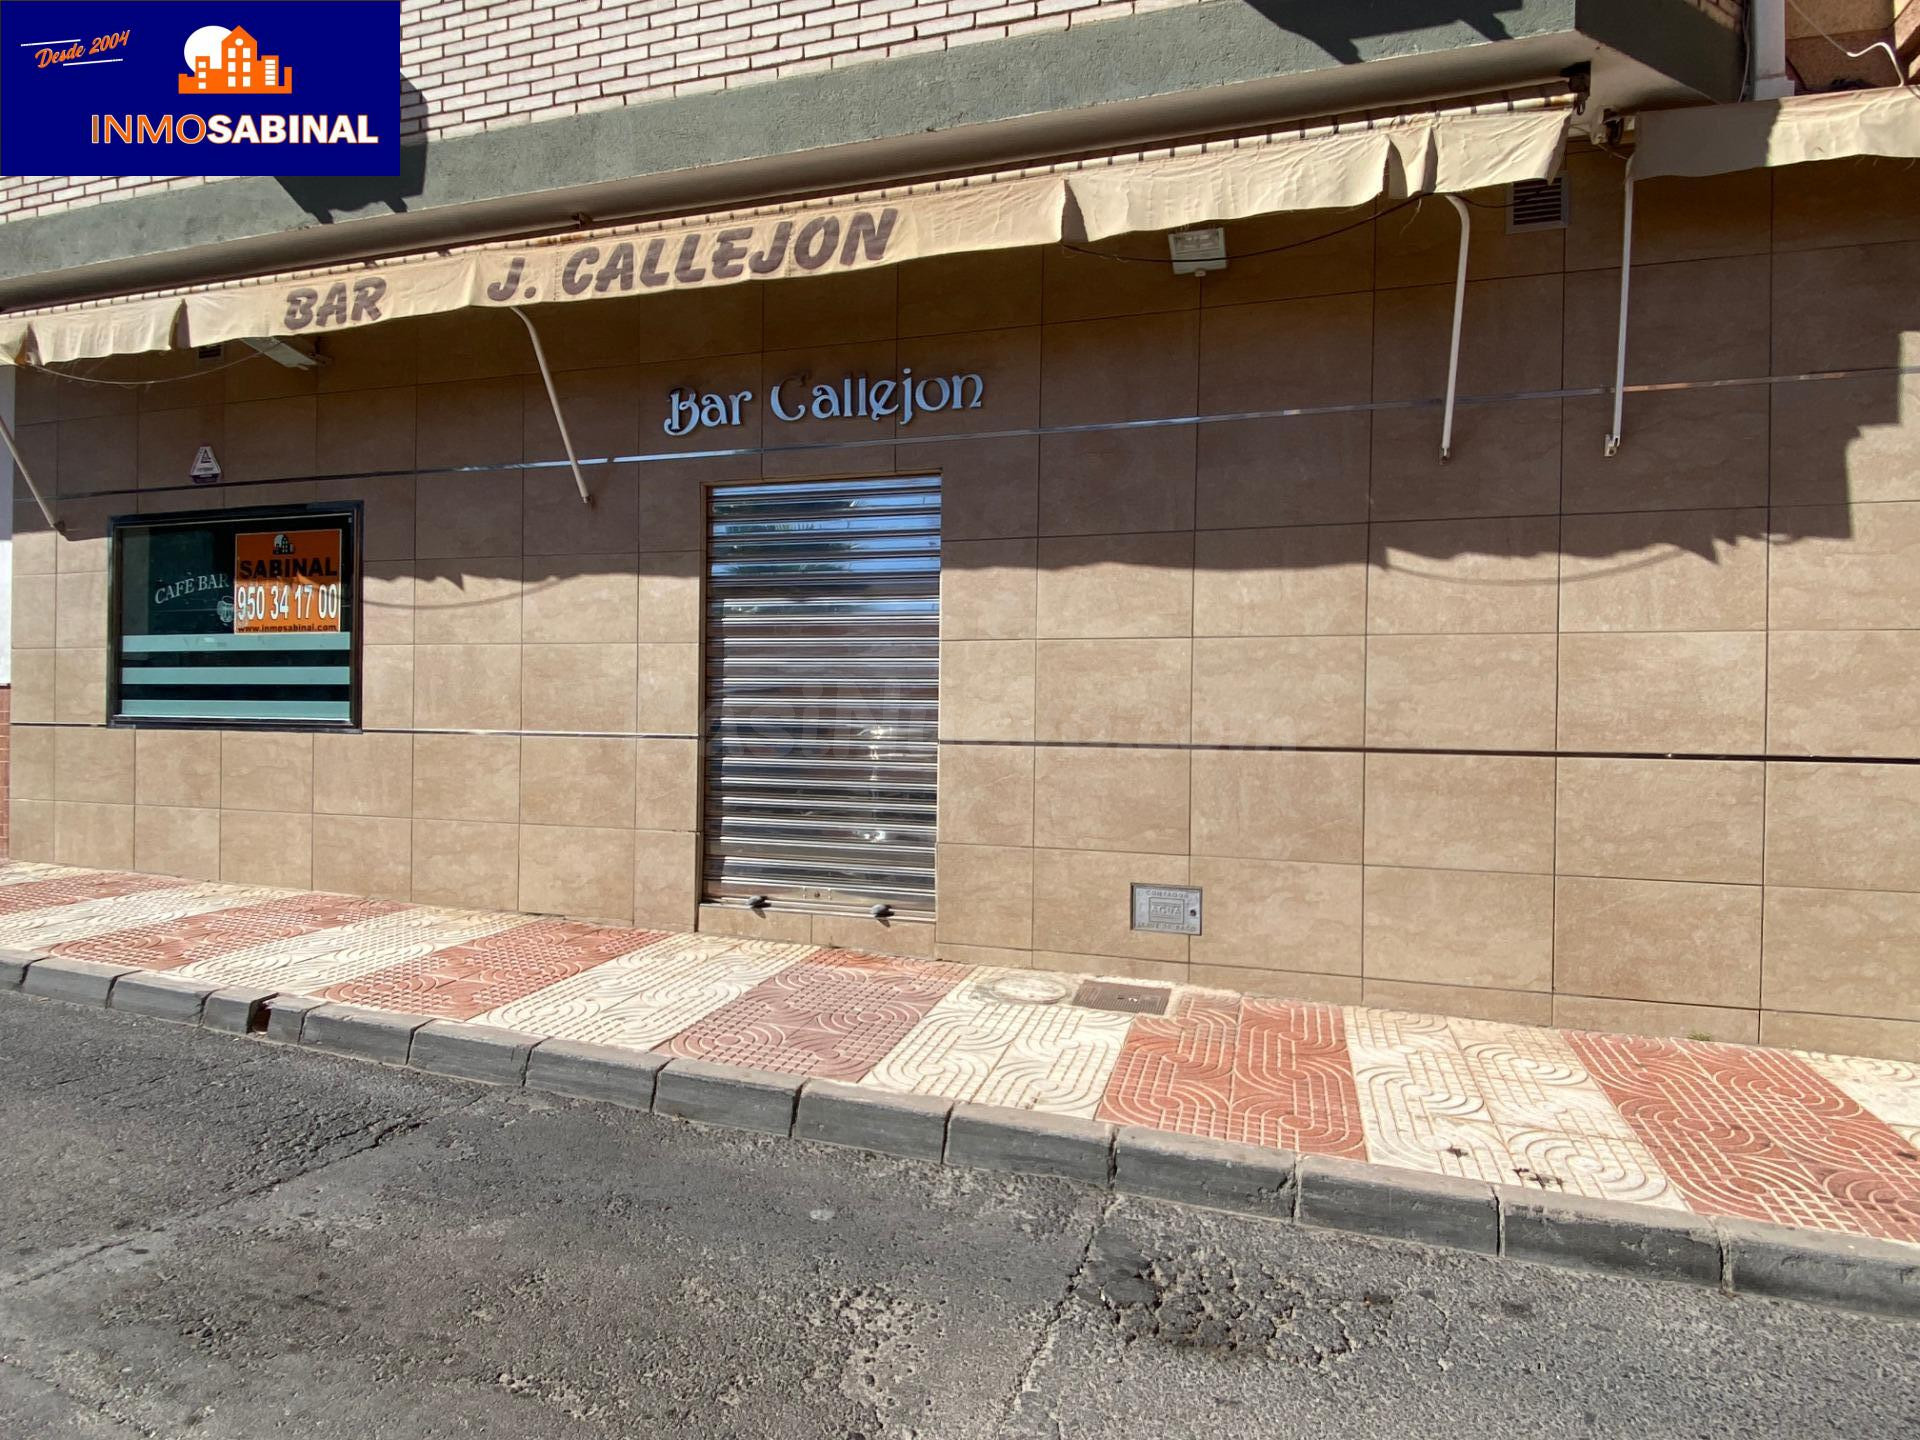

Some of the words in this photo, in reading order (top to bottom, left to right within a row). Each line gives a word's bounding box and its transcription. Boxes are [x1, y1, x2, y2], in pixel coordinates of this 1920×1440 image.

[283, 276, 388, 332] BAR
[487, 256, 537, 302] J.
[561, 206, 900, 296] CALLEJON
[663, 384, 753, 437] Bar
[769, 367, 985, 426] Callejon
[198, 573, 230, 591] BAR
[239, 556, 338, 578] SABINAL
[237, 585, 265, 620] 950
[270, 584, 289, 620] 34
[294, 584, 313, 619] 17
[318, 583, 337, 619] 00
